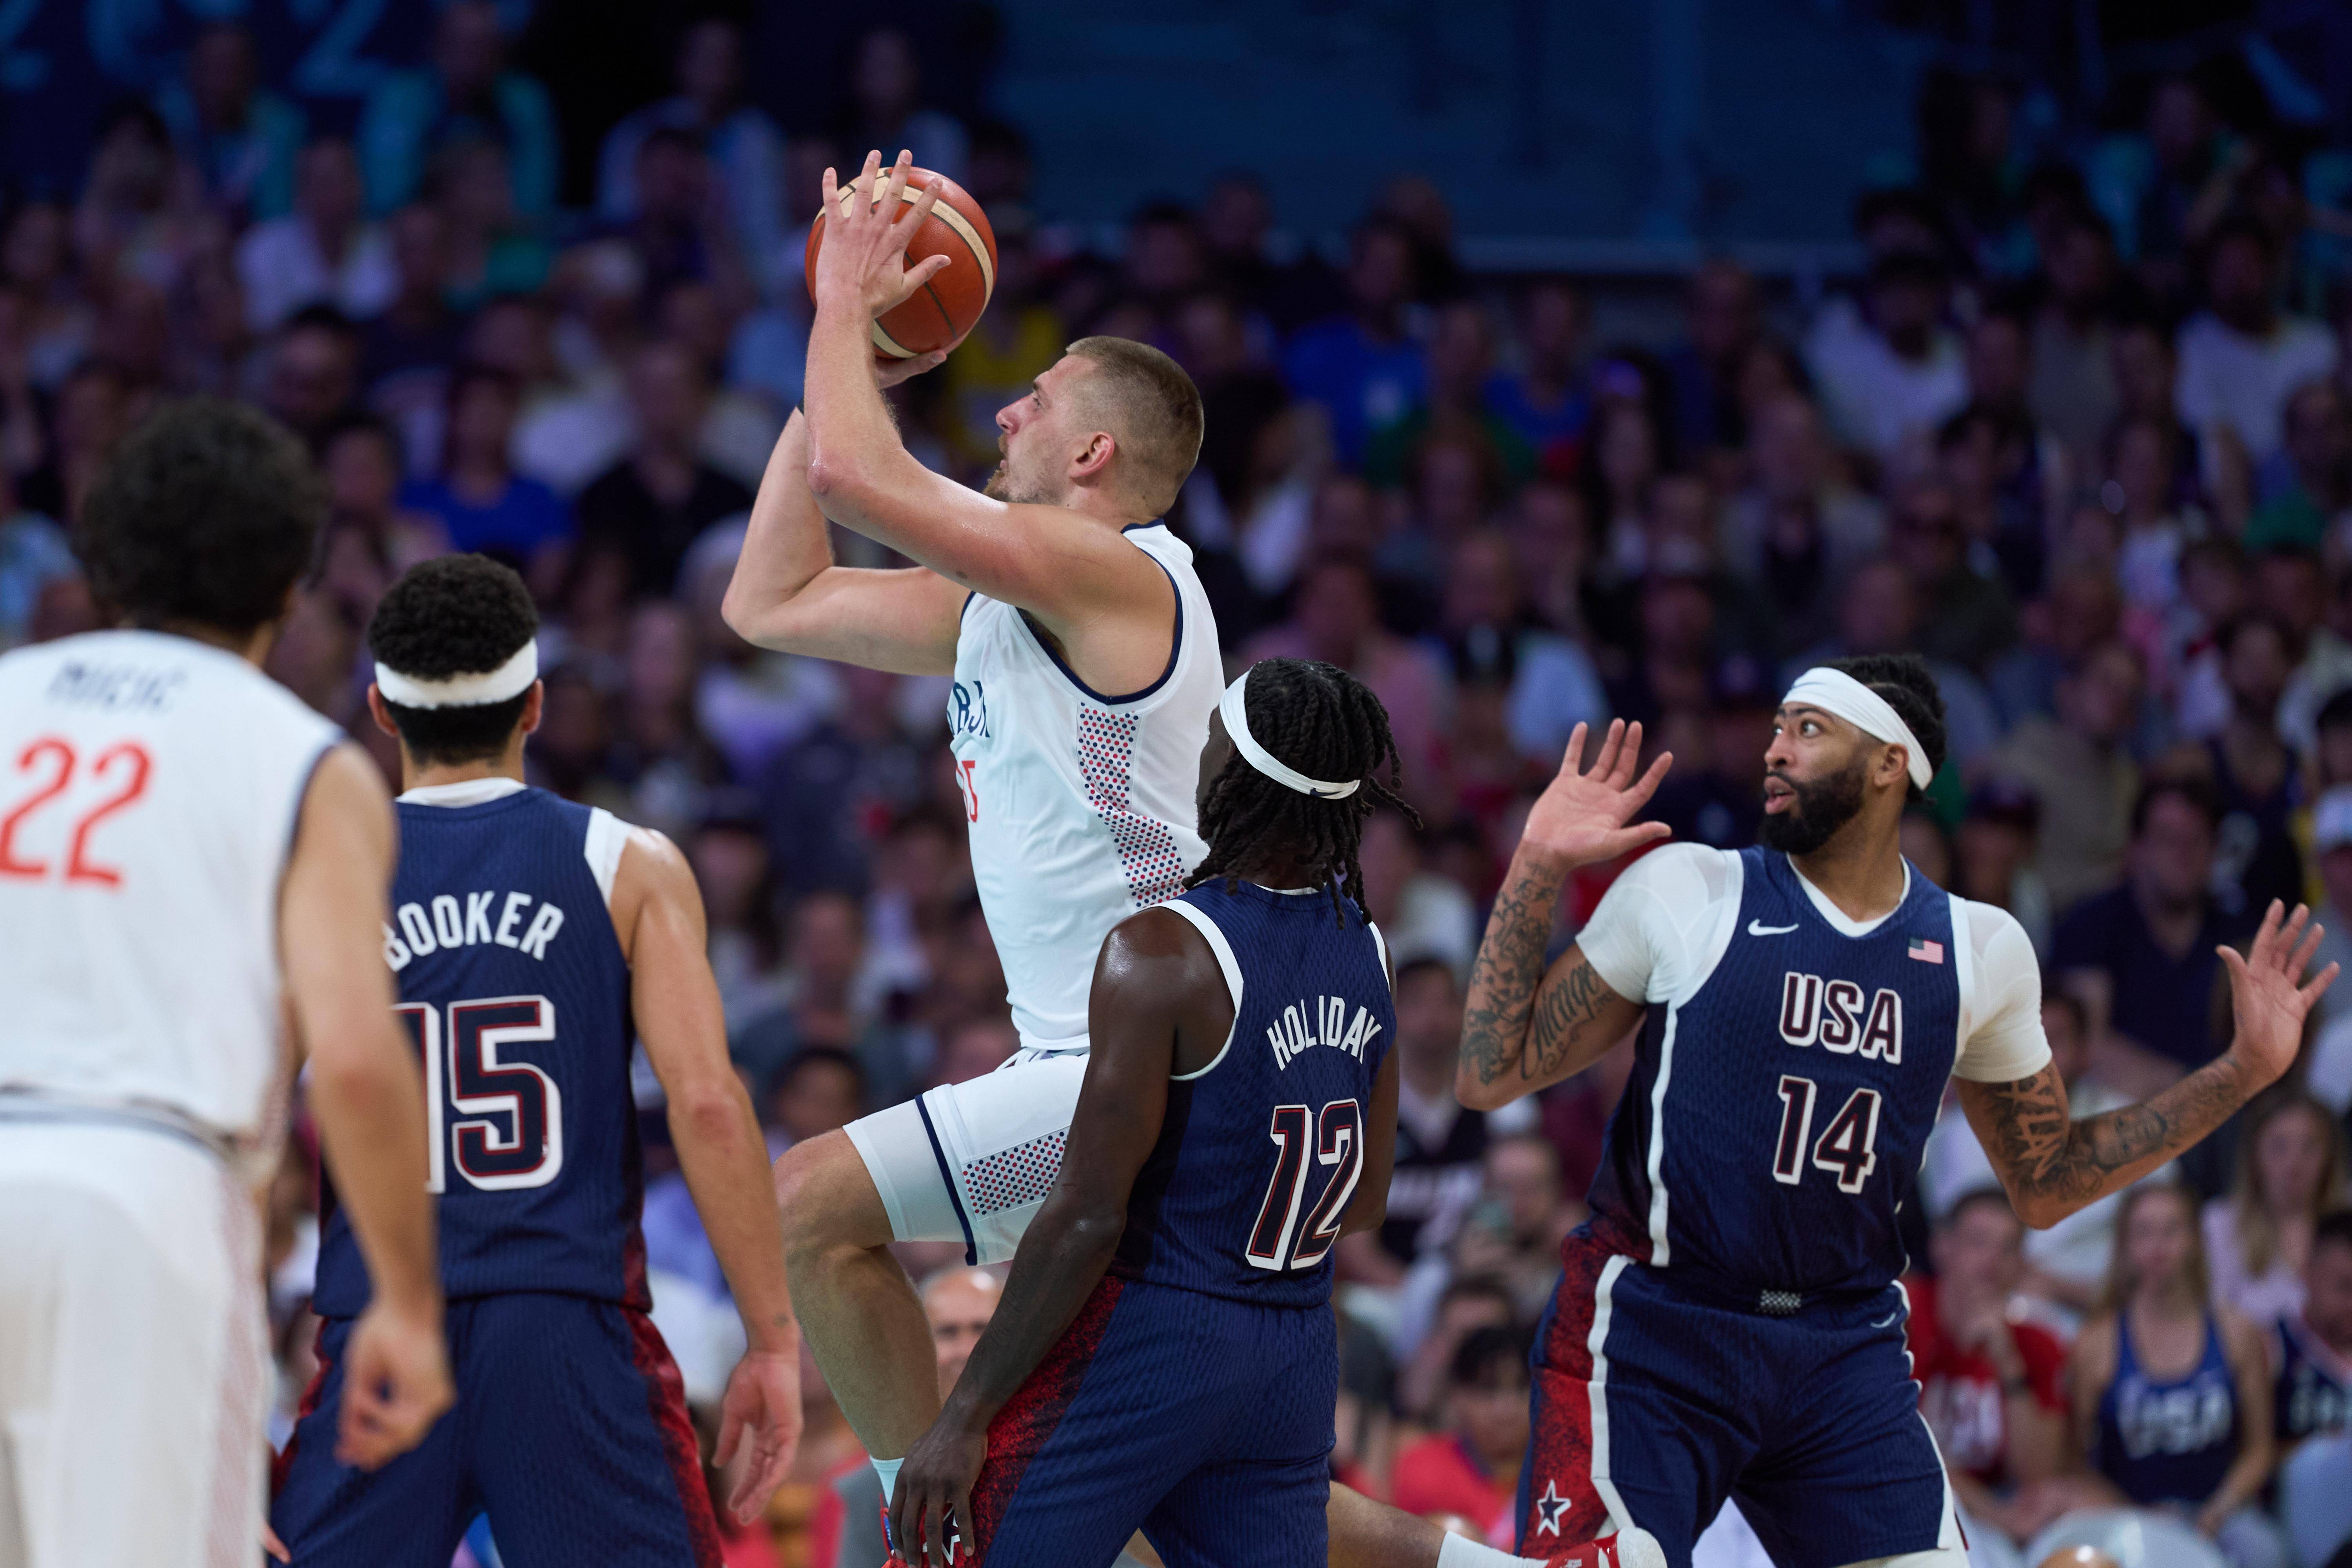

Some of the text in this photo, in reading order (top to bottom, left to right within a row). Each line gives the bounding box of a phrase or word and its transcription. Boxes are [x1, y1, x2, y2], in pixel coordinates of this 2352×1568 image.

[0, 736, 152, 888] 22
[955, 759, 978, 823] 5
[382, 890, 565, 972] BOOKER
[1266, 995, 1382, 1072] HOLIDAY
[1779, 971, 1903, 1065] USA
[1772, 1074, 1882, 1194] 14
[1245, 1098, 1364, 1272] 12
